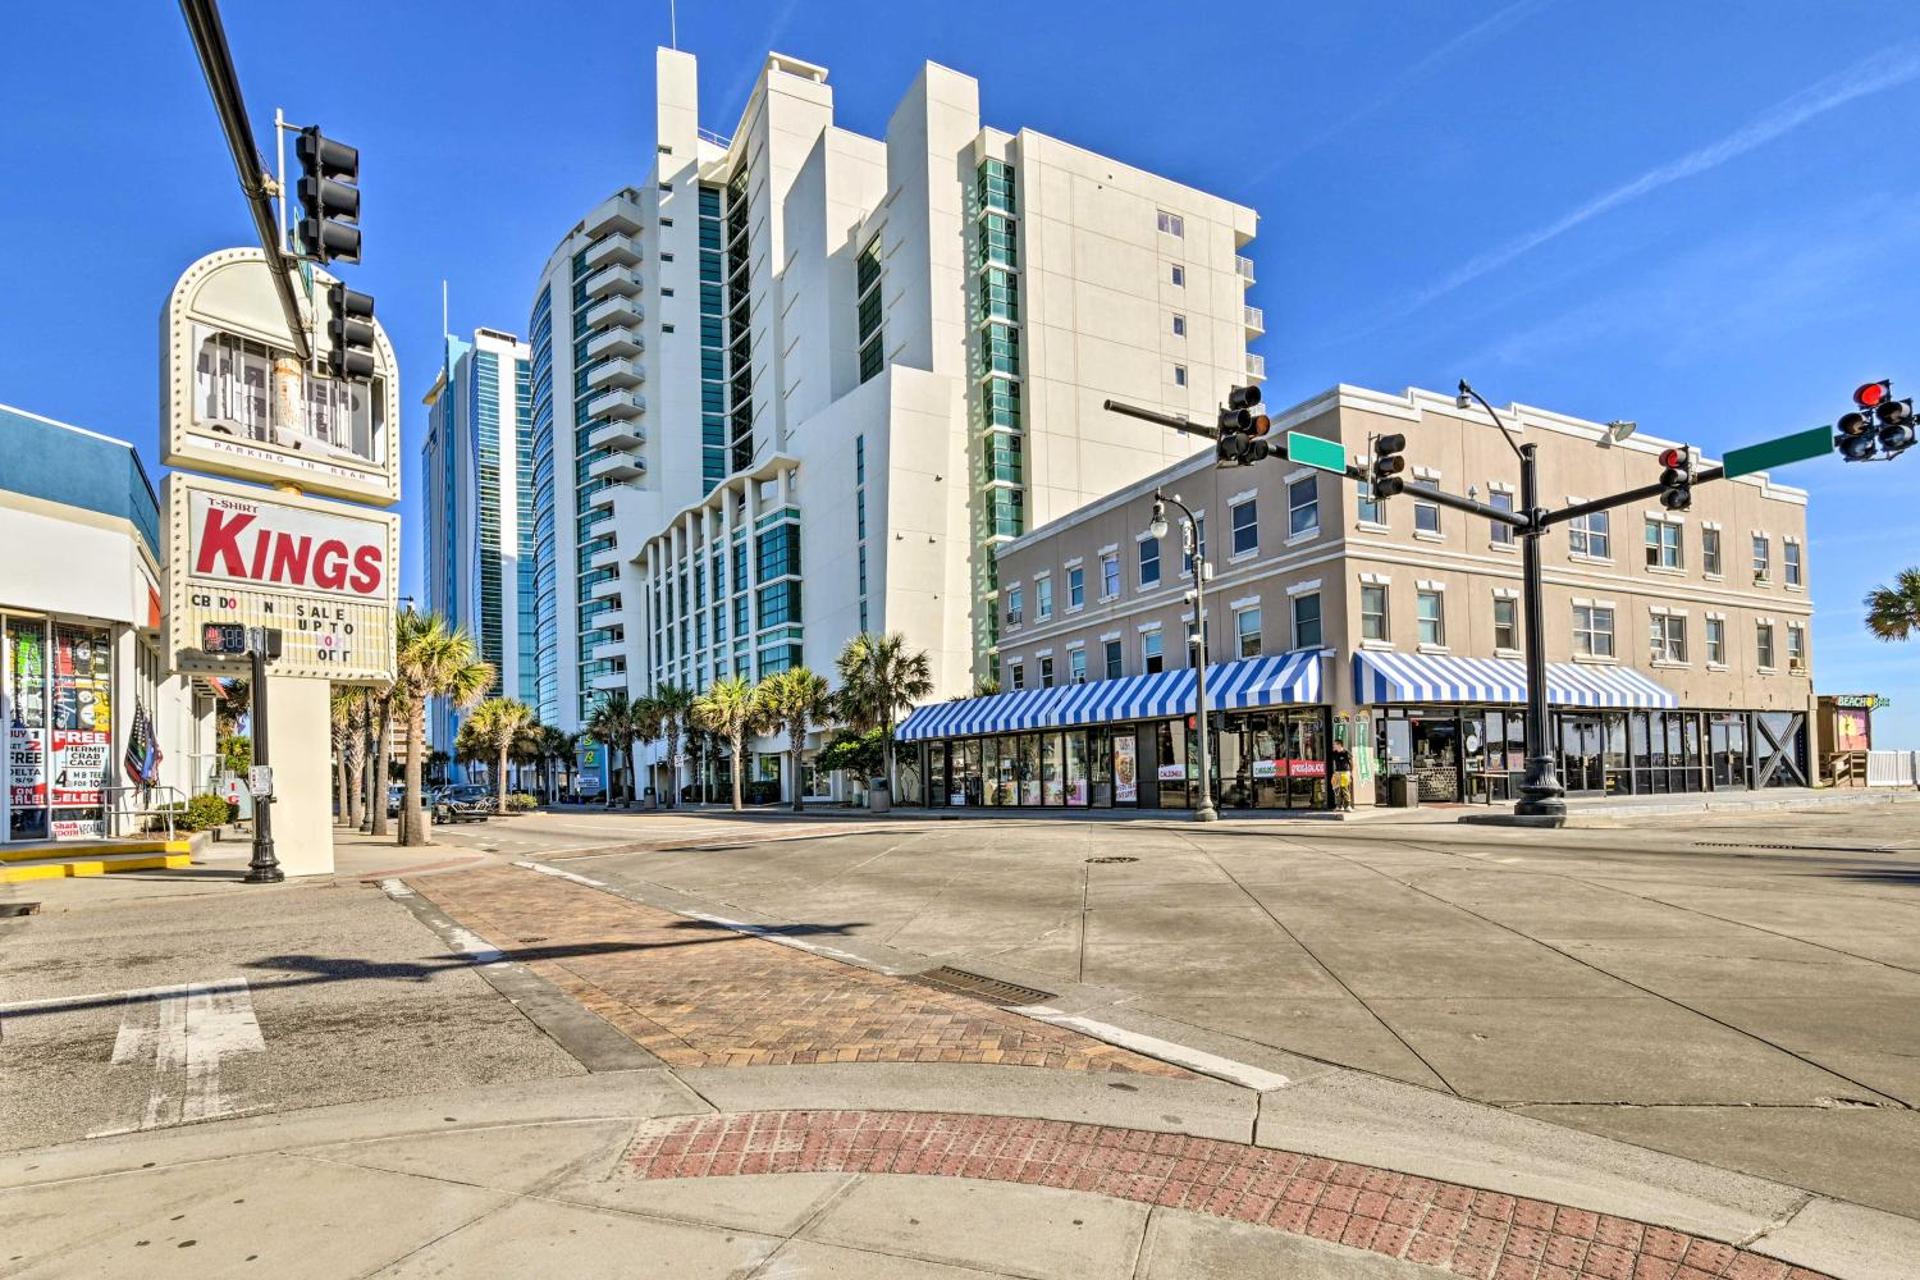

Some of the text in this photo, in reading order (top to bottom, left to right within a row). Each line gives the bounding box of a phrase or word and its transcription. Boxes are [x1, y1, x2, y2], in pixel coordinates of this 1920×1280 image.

[214, 441, 366, 480] PARKING IN REAR
[208, 497, 258, 514] T-SHIRT
[196, 507, 382, 594] KINGS
[54, 731, 107, 743] FREE
[70, 752, 101, 760] CRAB
[55, 770, 68, 788] 4
